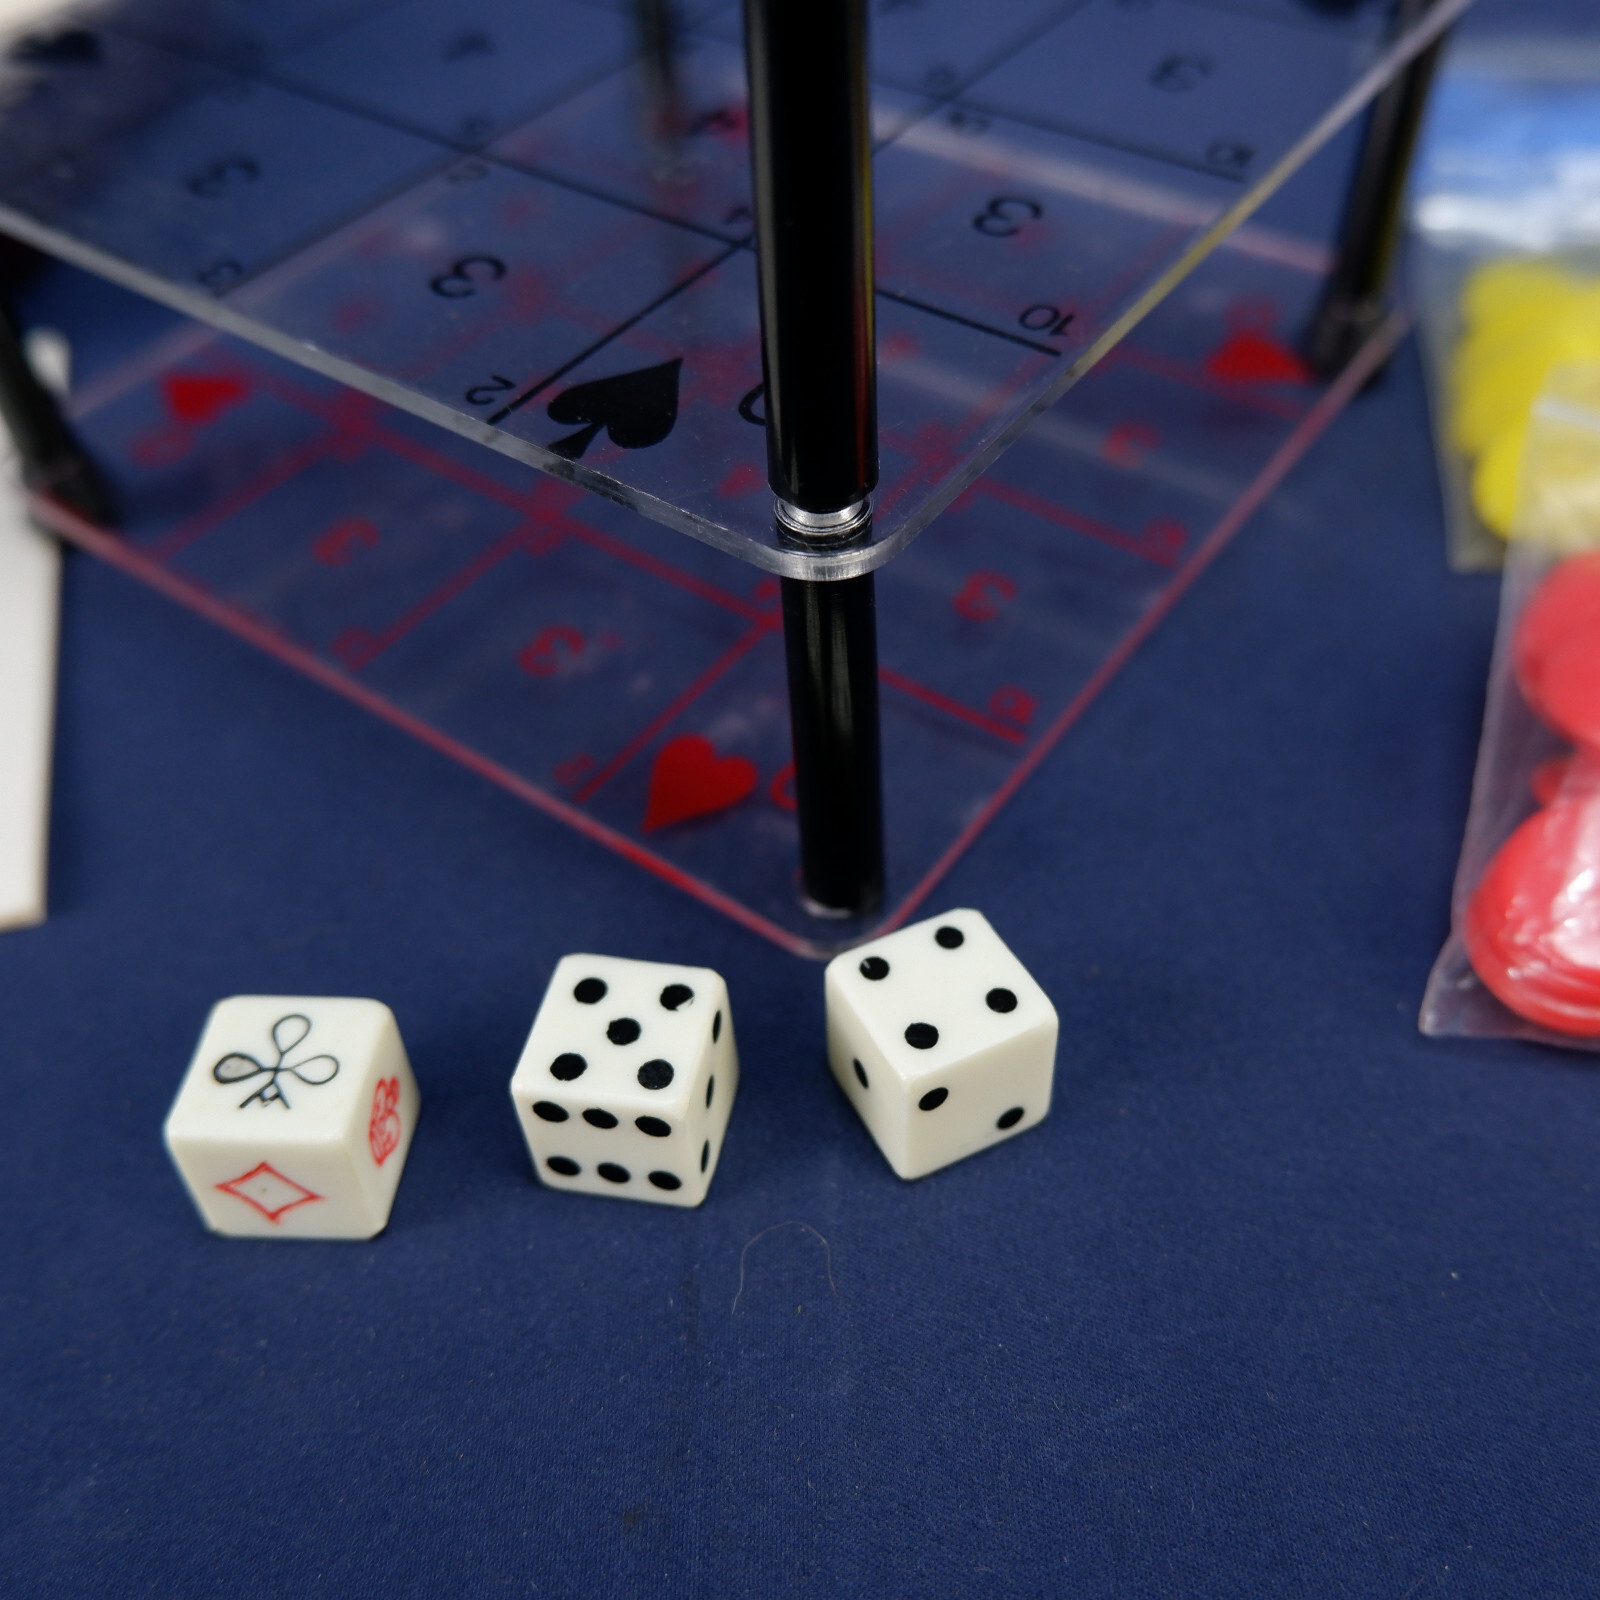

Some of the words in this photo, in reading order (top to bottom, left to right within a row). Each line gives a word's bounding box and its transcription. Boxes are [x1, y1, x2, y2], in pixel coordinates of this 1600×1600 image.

[972, 195, 1043, 237] 3
[429, 255, 506, 298] 3
[1018, 304, 1075, 336] 10
[465, 375, 517, 405] 2
[952, 568, 1017, 622] 3
[516, 622, 584, 677] 3
